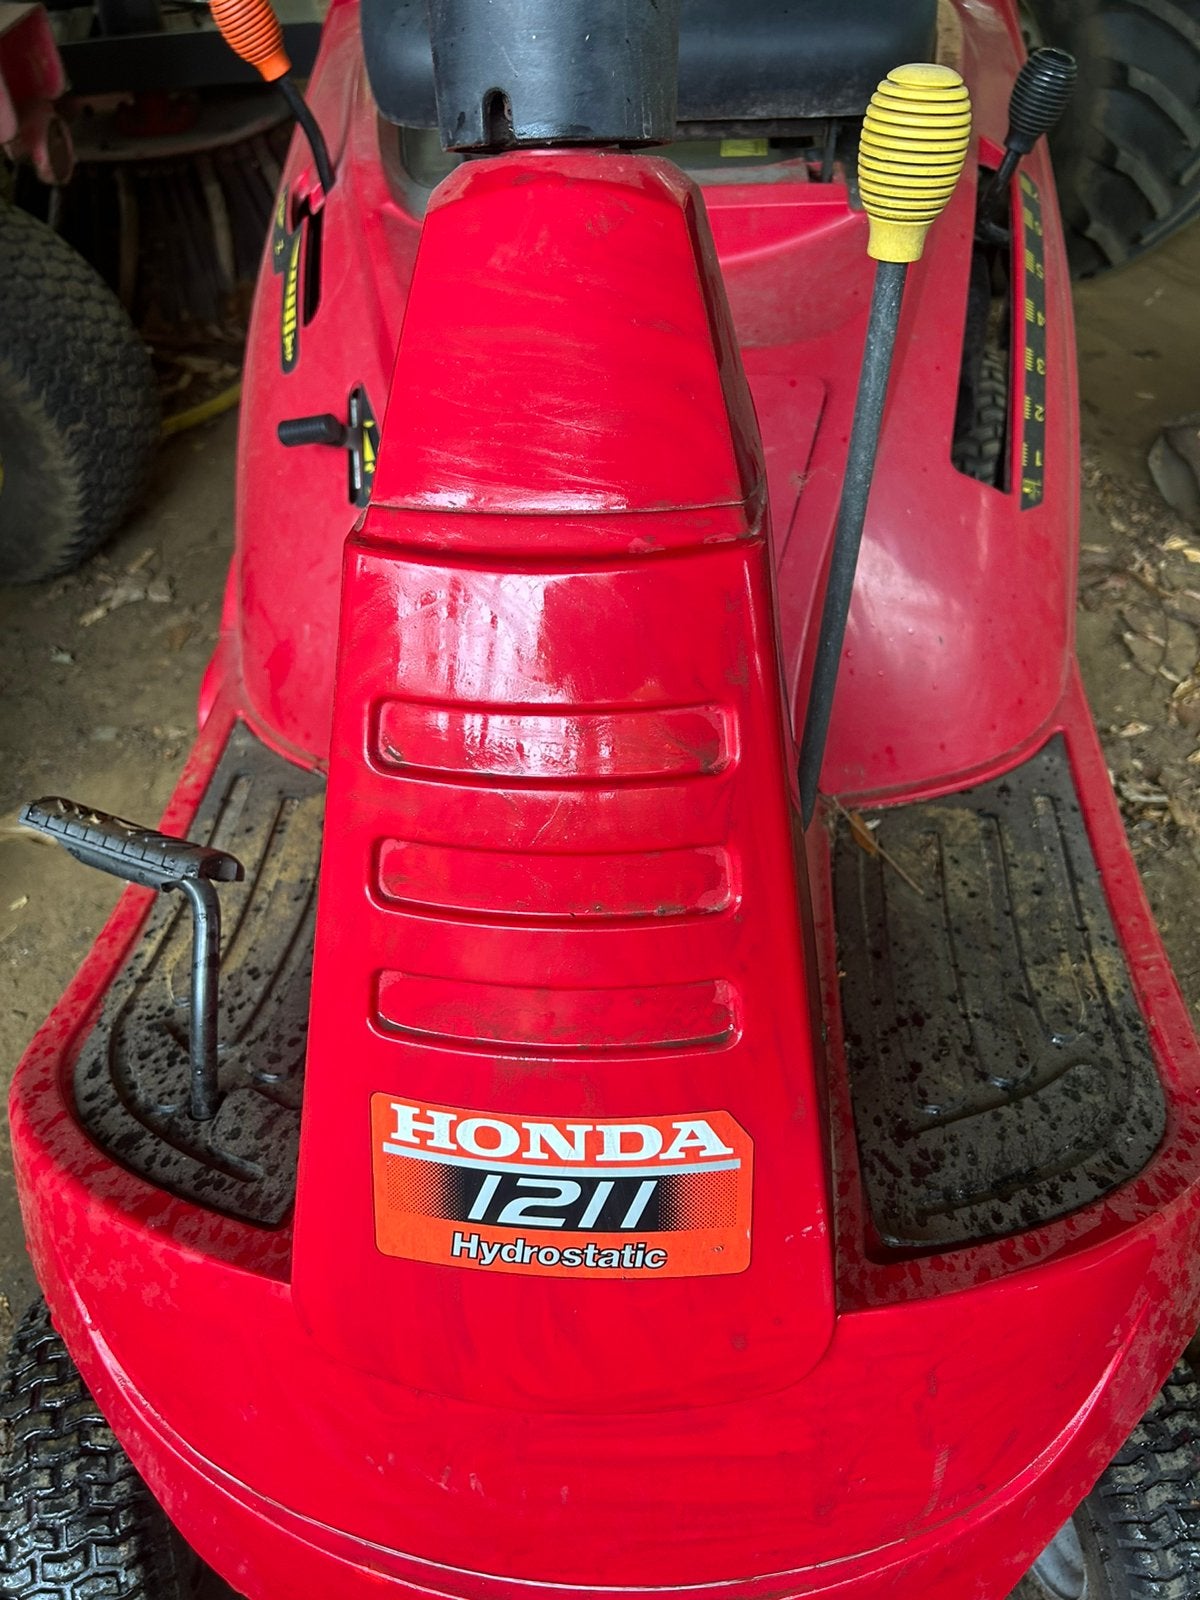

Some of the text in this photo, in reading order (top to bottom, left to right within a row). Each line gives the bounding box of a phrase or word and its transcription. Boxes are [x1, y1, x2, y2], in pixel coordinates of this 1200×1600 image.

[1035, 263, 1044, 280] 5
[1036, 311, 1046, 327] 4
[1036, 357, 1046, 375] 3
[1034, 404, 1045, 422] 2
[1034, 450, 1043, 467] 1
[390, 1102, 734, 1161] HONDA
[467, 1174, 658, 1229] 1211
[451, 1231, 668, 1270] Hydrostatic
